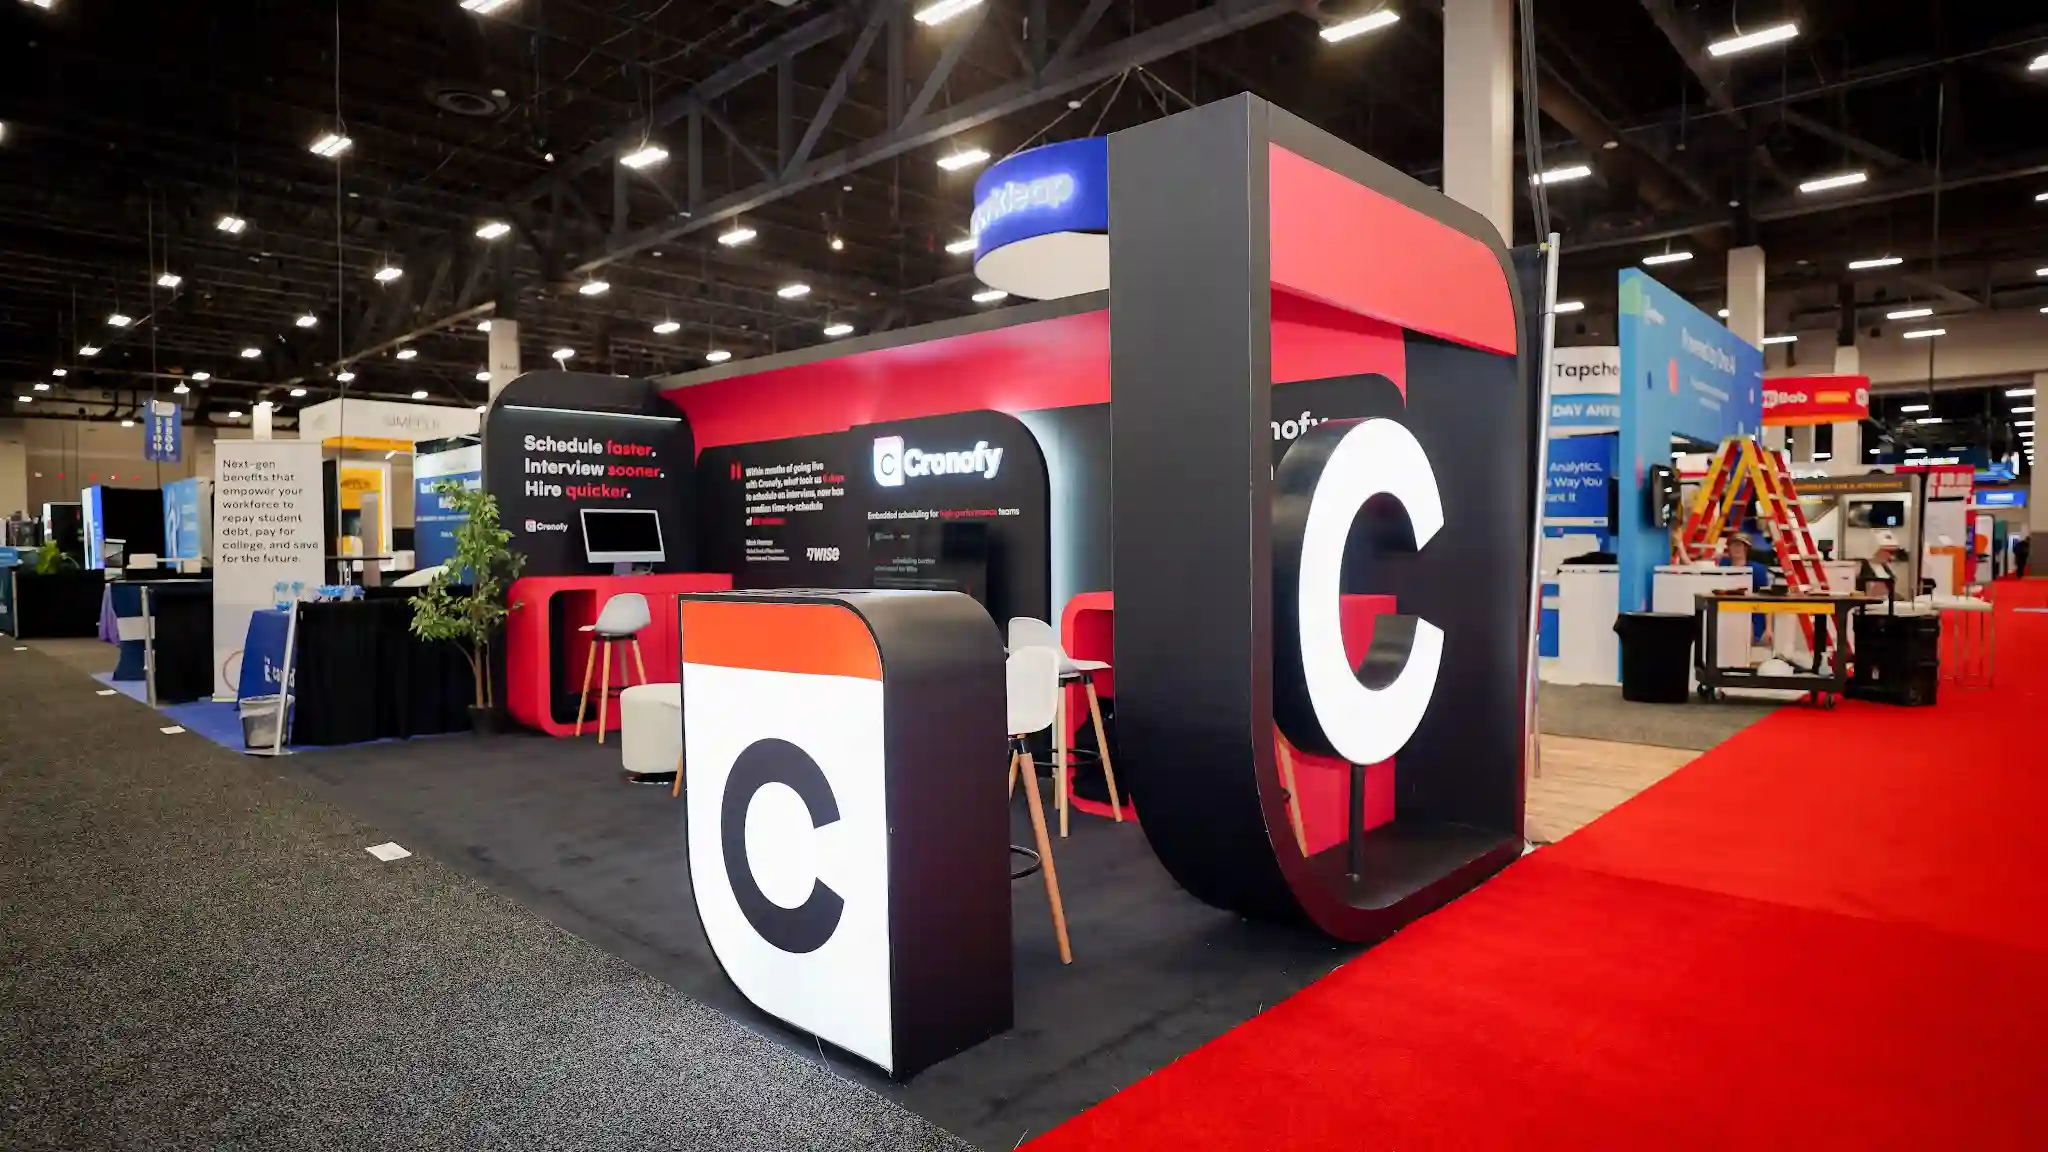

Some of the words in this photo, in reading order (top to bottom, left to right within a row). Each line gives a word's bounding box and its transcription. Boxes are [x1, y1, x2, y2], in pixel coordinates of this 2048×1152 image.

[524, 434, 603, 455] Schedule
[607, 440, 657, 457] faster.
[223, 460, 276, 470] Next-gen
[904, 441, 1004, 479] Cronofy
[525, 457, 604, 476] Interview
[607, 464, 665, 479] sooner.
[812, 461, 824, 471] live
[223, 473, 269, 482] benefits
[272, 473, 295, 482] that
[1554, 476, 1580, 489] Way
[1582, 475, 1603, 487] You
[223, 488, 275, 497] empower
[279, 488, 303, 497] your
[525, 480, 562, 497] Hire
[565, 482, 632, 500] quicker.
[222, 500, 280, 509] workforce
[283, 501, 294, 509] to
[867, 511, 898, 520] Embedded
[898, 509, 929, 520] scheduling
[930, 509, 939, 518] for
[998, 507, 1020, 516] teams
[222, 515, 255, 524] repay
[258, 514, 303, 523] student
[255, 528, 276, 537] pay
[279, 527, 295, 536] for
[537, 522, 568, 533] Cronofy
[269, 541, 290, 549] and
[293, 541, 319, 549] save
[222, 554, 238, 563] for
[241, 554, 260, 563] the
[1299, 417, 1445, 765] C
[720, 737, 845, 954] C
